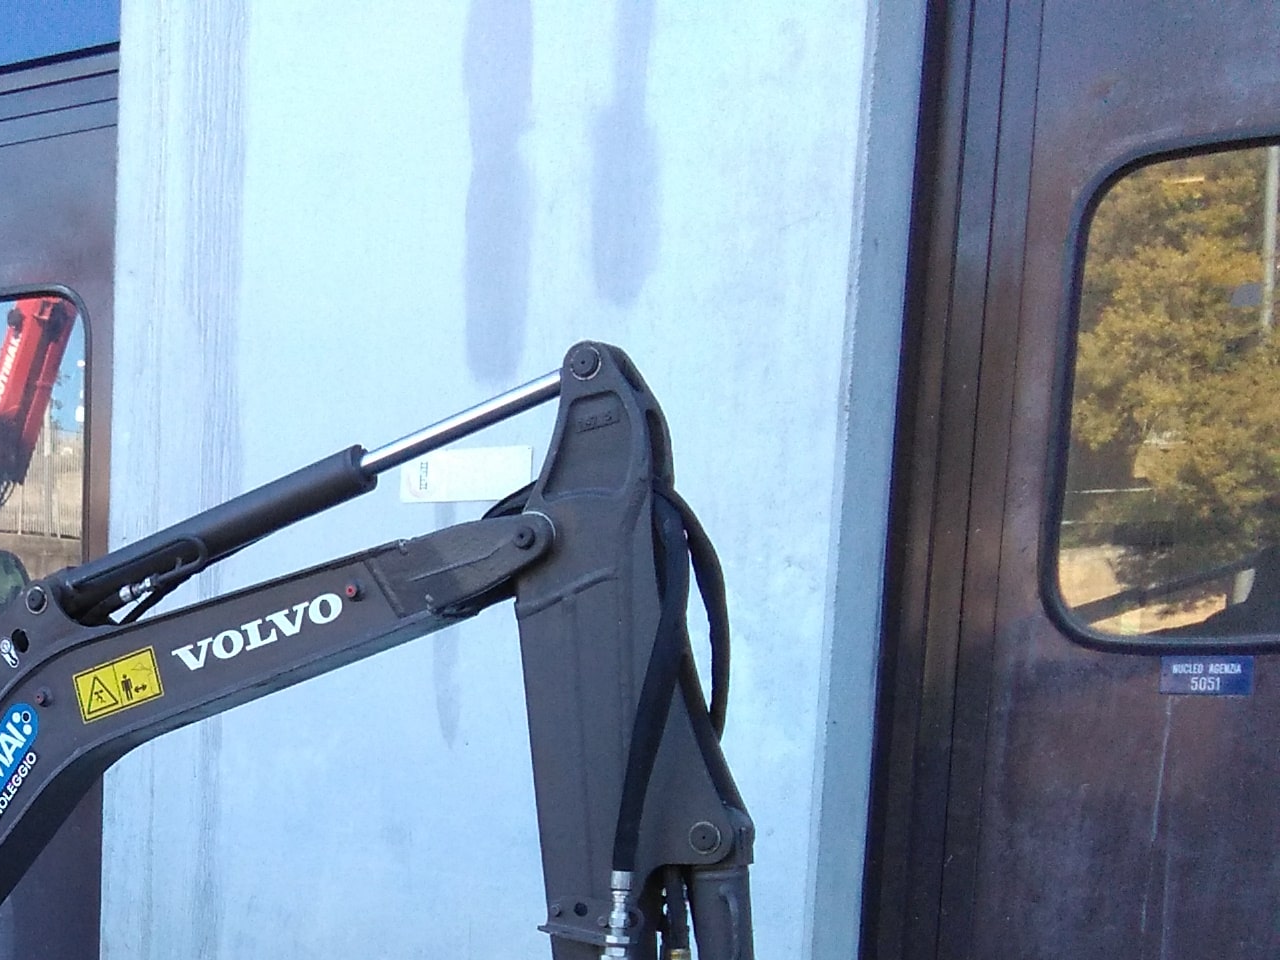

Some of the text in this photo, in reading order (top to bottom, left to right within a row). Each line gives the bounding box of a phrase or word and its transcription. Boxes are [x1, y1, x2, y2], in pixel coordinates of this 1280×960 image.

[171, 592, 344, 671] VOLVO
[1172, 663, 1242, 674] NUCLEO AGENZIA
[1190, 677, 1221, 691] 5051
